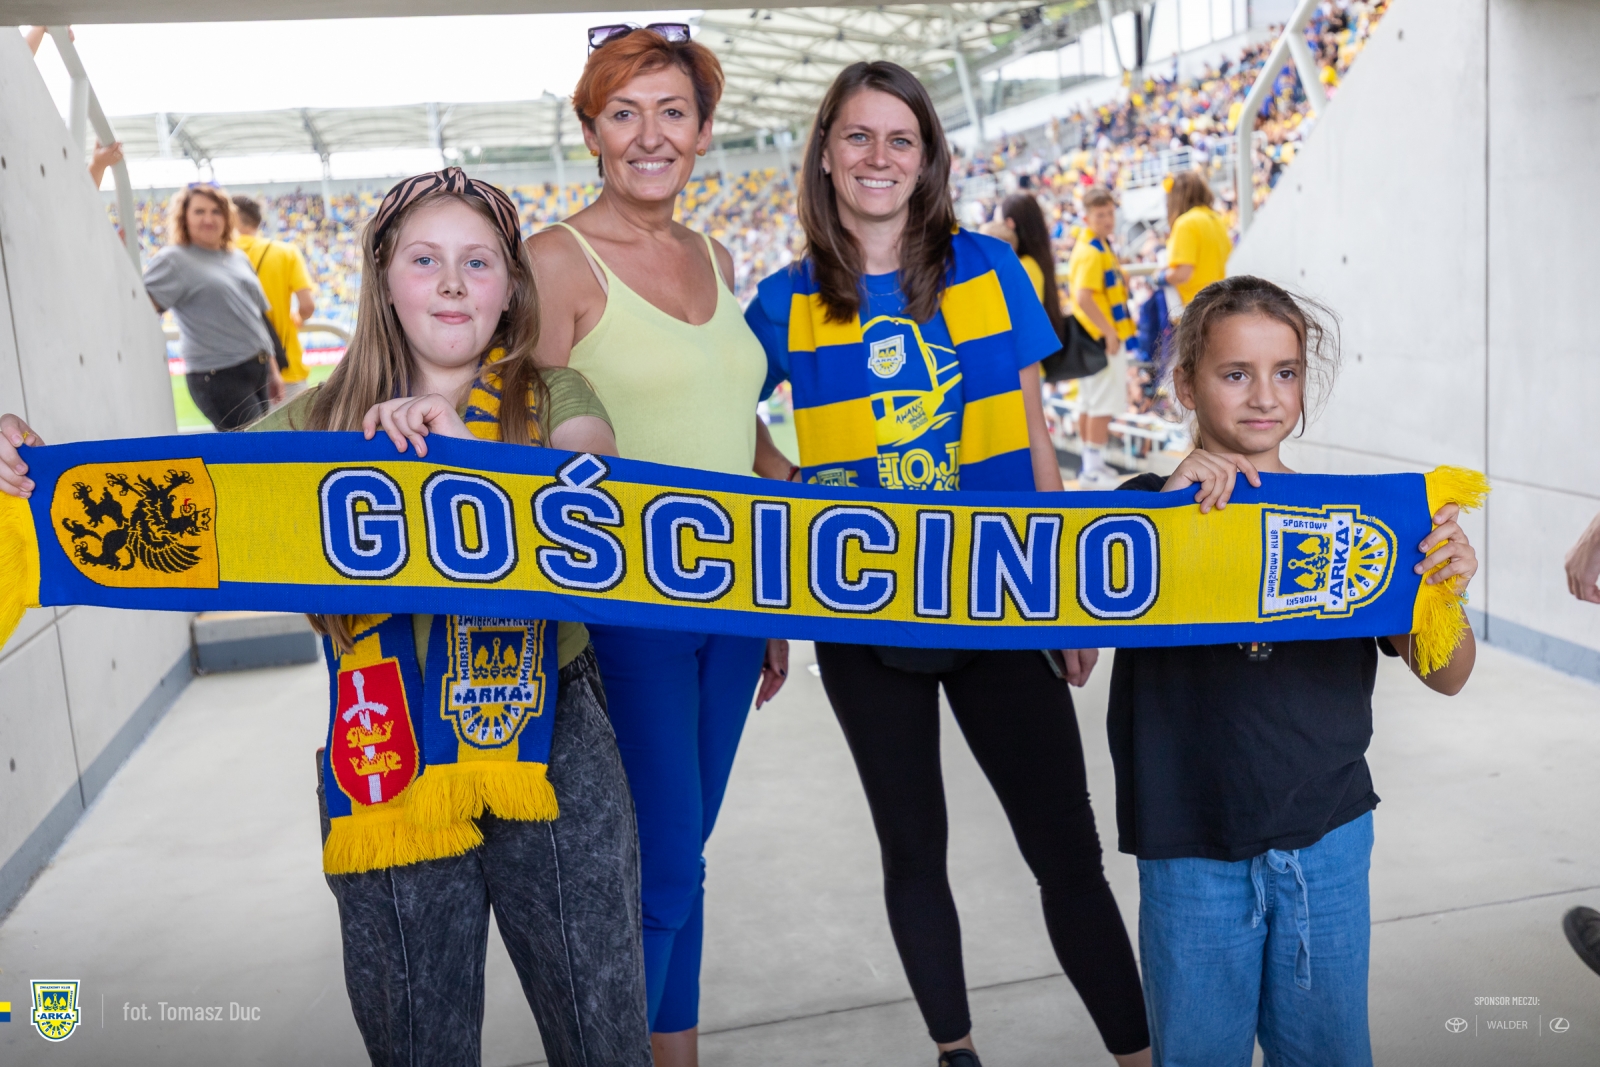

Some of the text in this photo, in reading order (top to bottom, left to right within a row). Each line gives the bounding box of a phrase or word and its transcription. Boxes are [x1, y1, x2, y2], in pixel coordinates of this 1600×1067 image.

[318, 453, 1160, 621] GOŚCICINO
[1283, 519, 1328, 530] SPORTOWY
[1267, 529, 1279, 598] ZWIĄZKOWY KLUB
[1329, 526, 1350, 600] ARKA
[1286, 595, 1317, 606] MORSKI
[458, 633, 470, 681] MORSKI
[519, 627, 536, 689] SPORTOWY
[462, 687, 524, 704] ARKA
